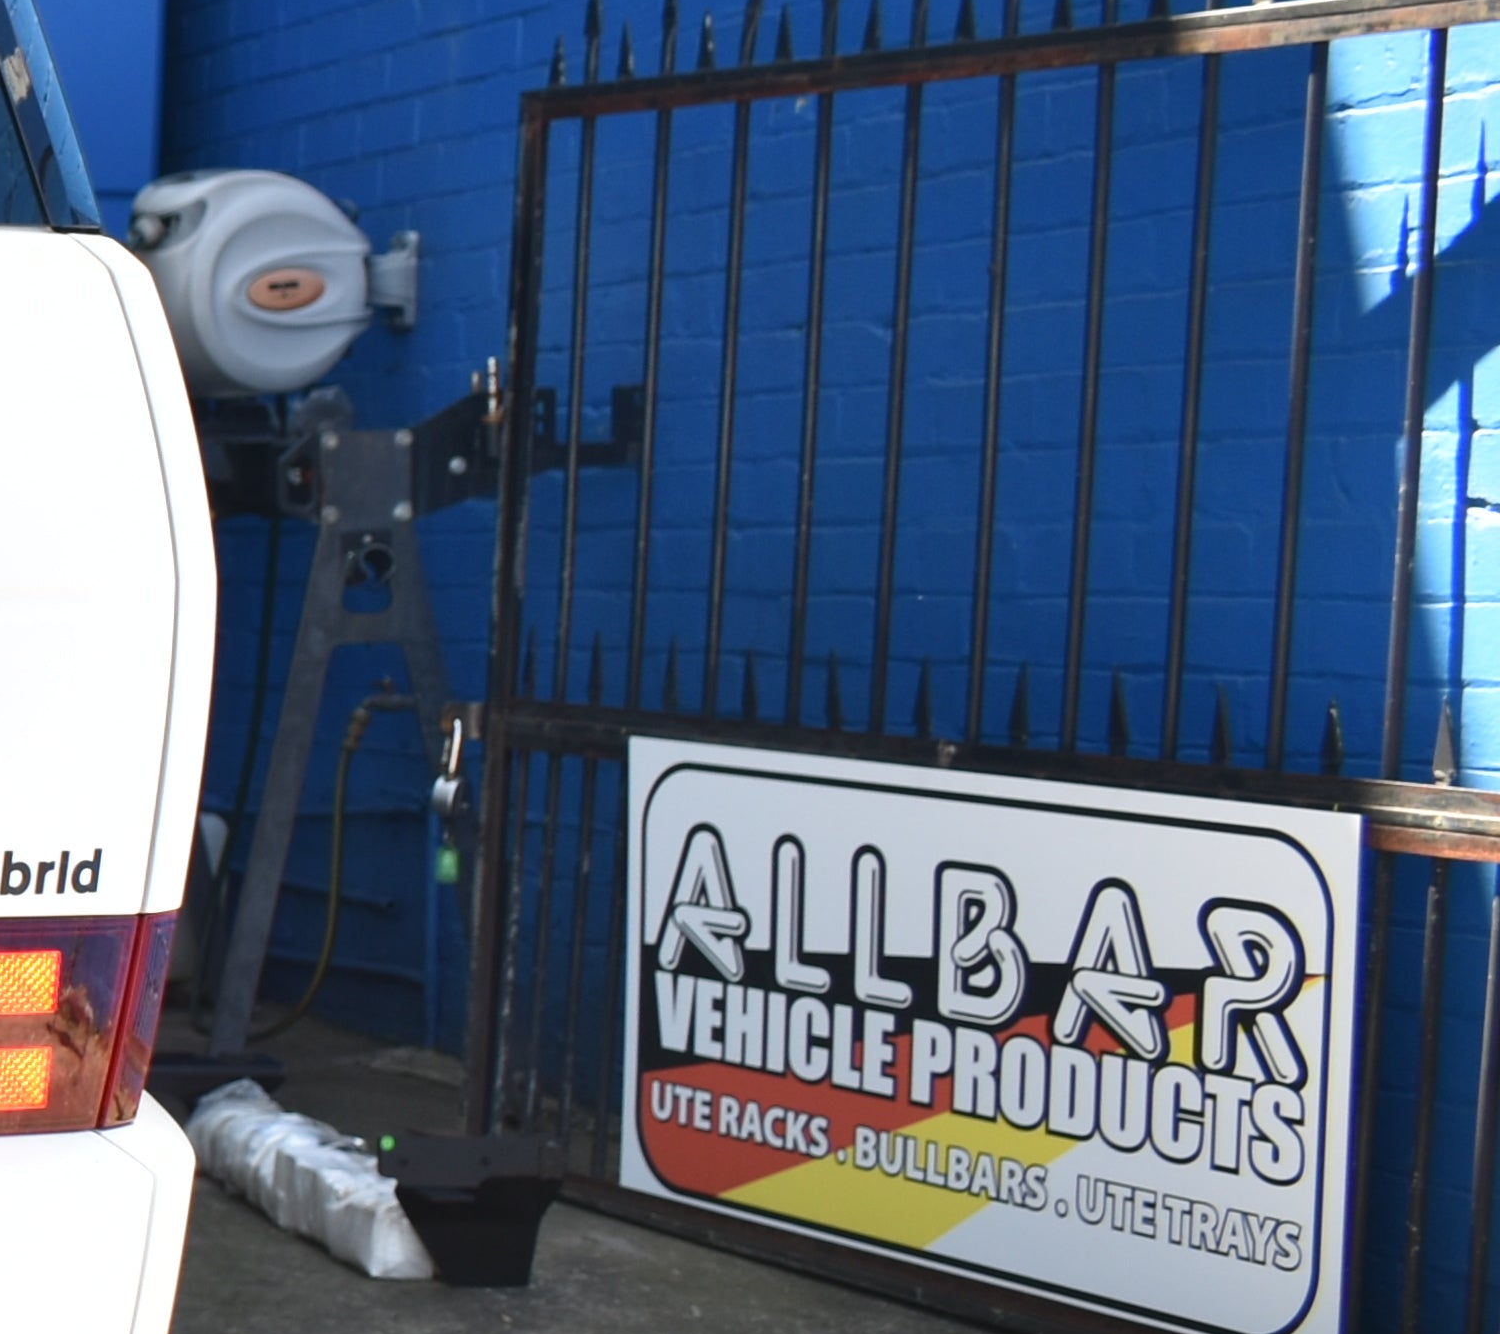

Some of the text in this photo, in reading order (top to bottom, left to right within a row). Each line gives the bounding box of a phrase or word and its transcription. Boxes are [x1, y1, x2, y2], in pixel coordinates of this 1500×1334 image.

[655, 823, 1308, 1087] ALLBAR
[650, 1079, 1302, 1272] UTE RACKS BULLBARS UTE TRAYS
[653, 968, 1306, 1186] VEHICLE PRODUCTS
